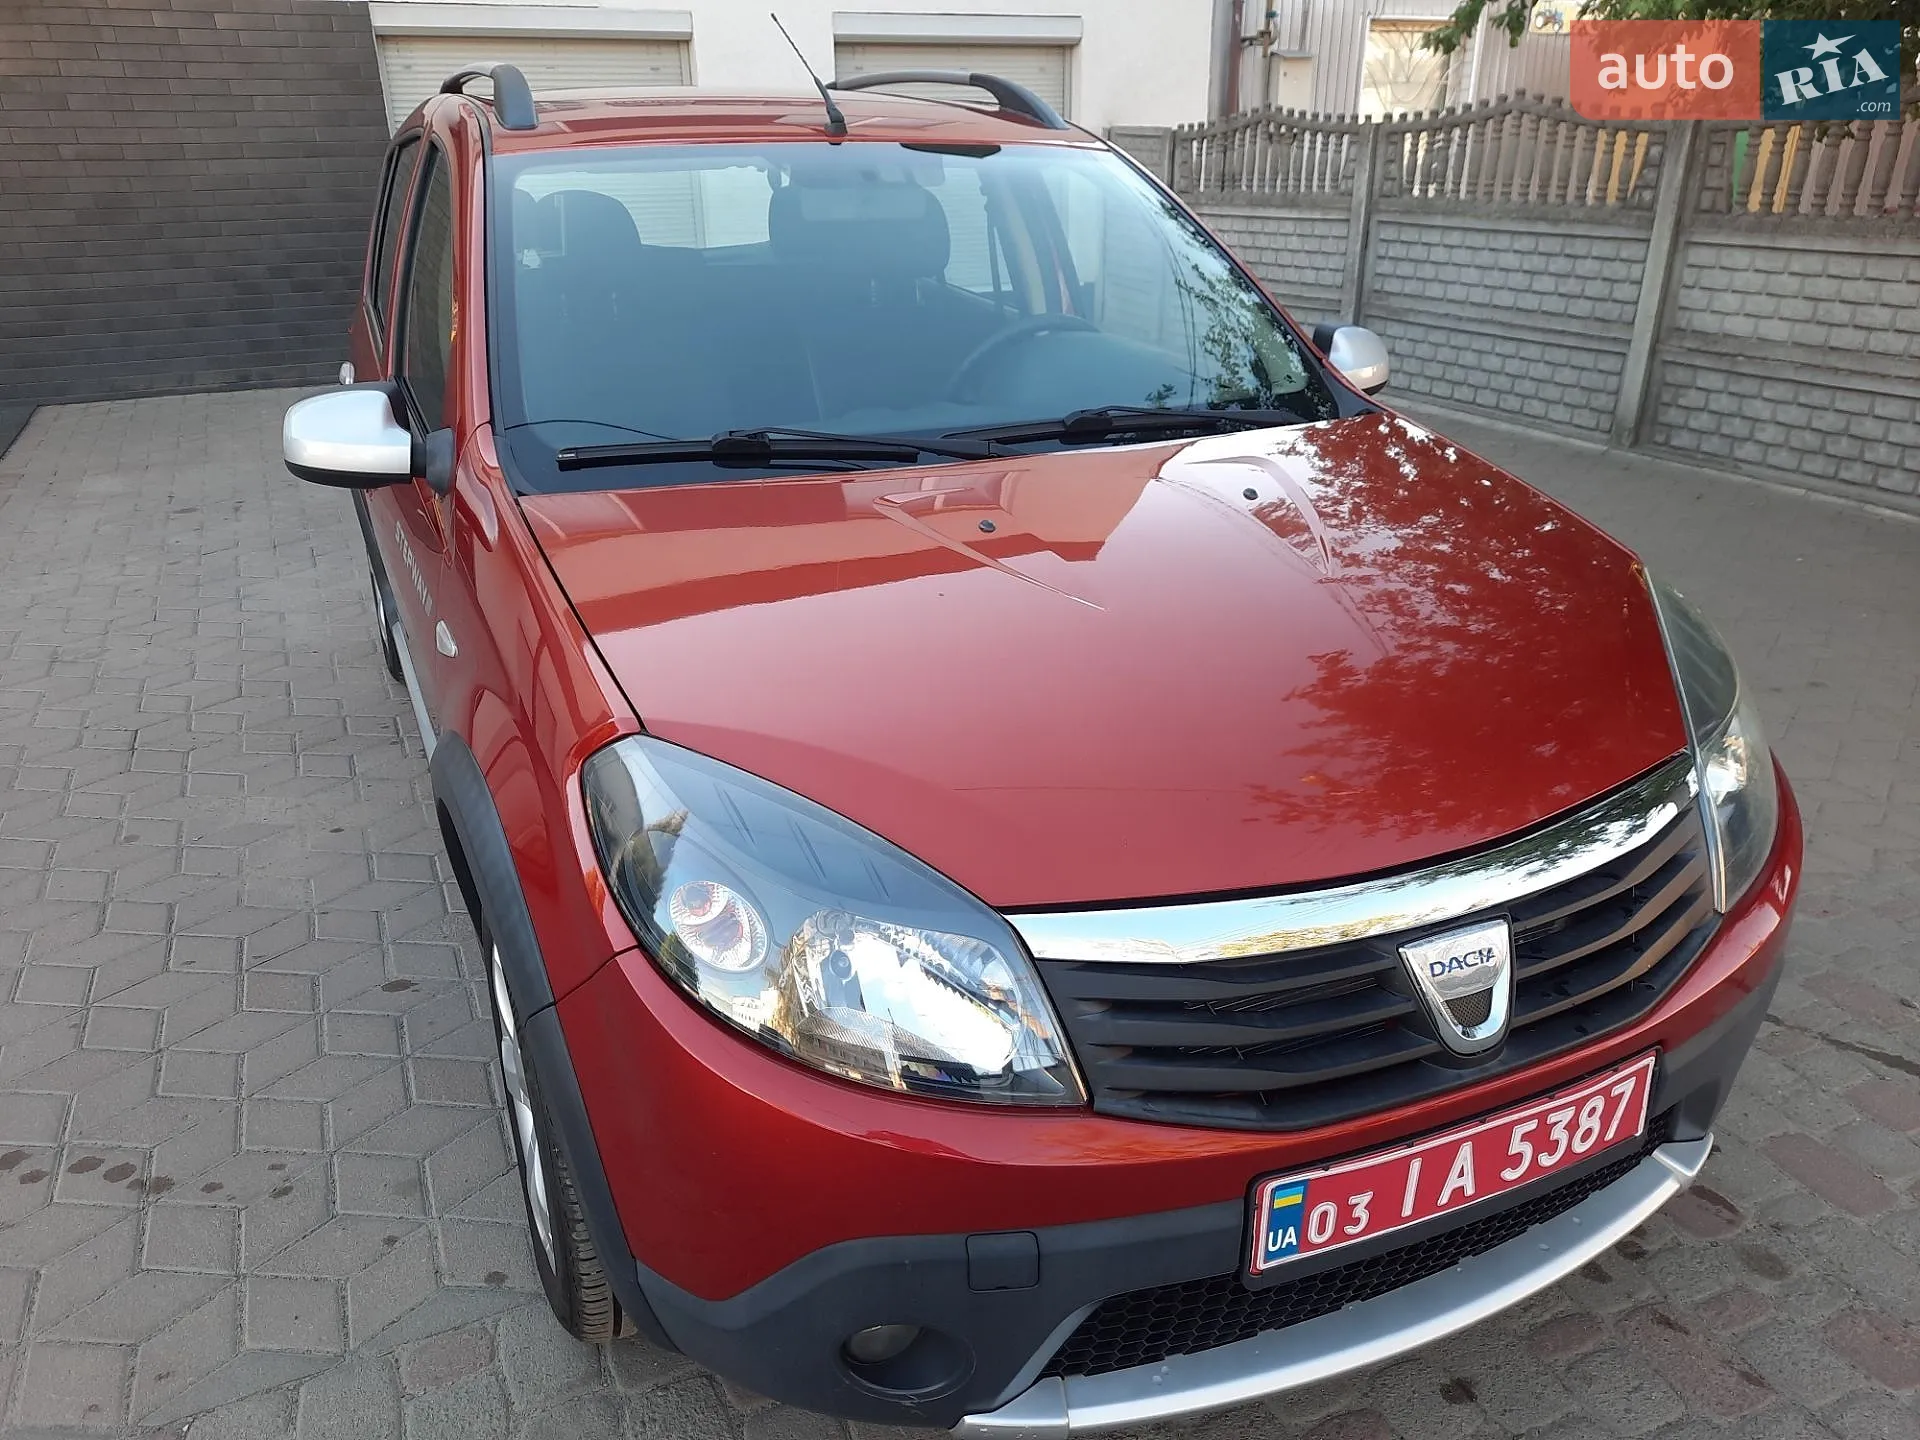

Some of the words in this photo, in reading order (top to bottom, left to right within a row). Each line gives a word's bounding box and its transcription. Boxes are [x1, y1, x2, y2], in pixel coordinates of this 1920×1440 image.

[1307, 1191, 1374, 1245] 03
[1500, 1076, 1637, 1182] 5387
[1268, 1226, 1297, 1252] UA
